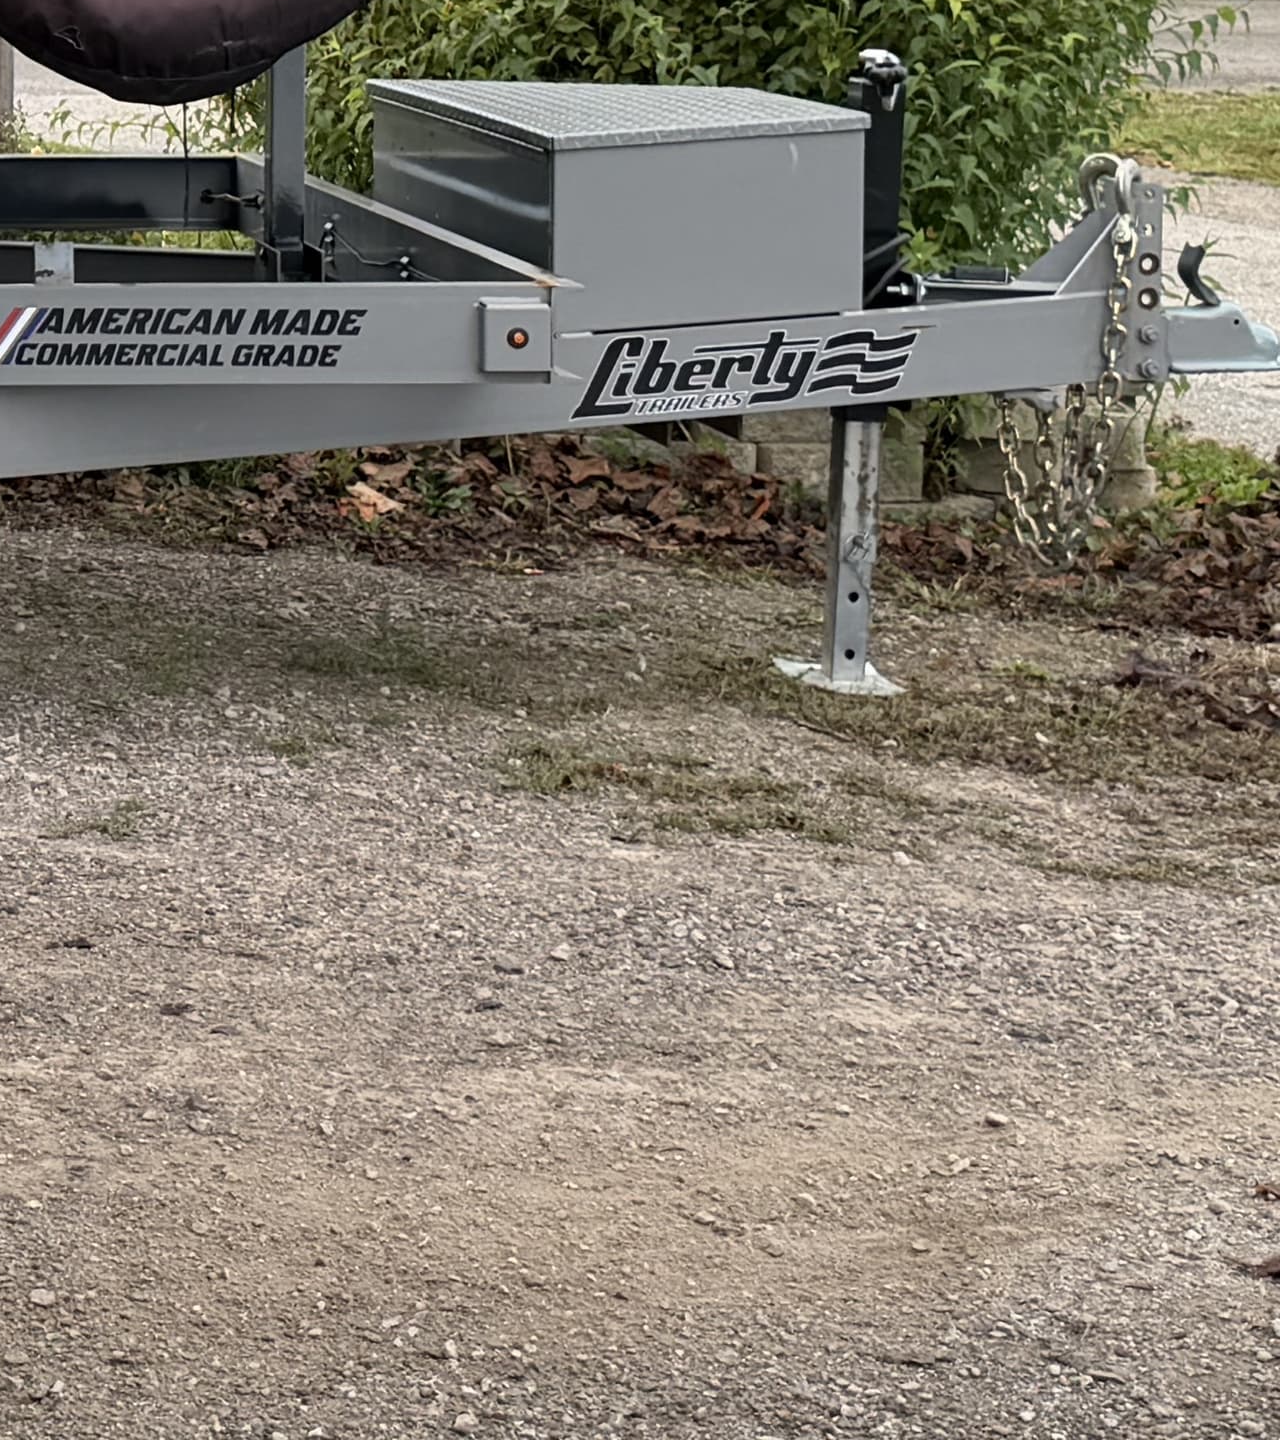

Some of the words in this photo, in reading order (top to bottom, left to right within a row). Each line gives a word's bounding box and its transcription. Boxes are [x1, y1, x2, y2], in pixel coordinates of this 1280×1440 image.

[40, 308, 246, 335] AMERICAN
[249, 309, 368, 335] MADE
[15, 343, 224, 366] COMMERCIAL
[231, 345, 342, 366] GRADE
[570, 330, 821, 421] Liberty
[636, 391, 749, 416] TRAILERS
